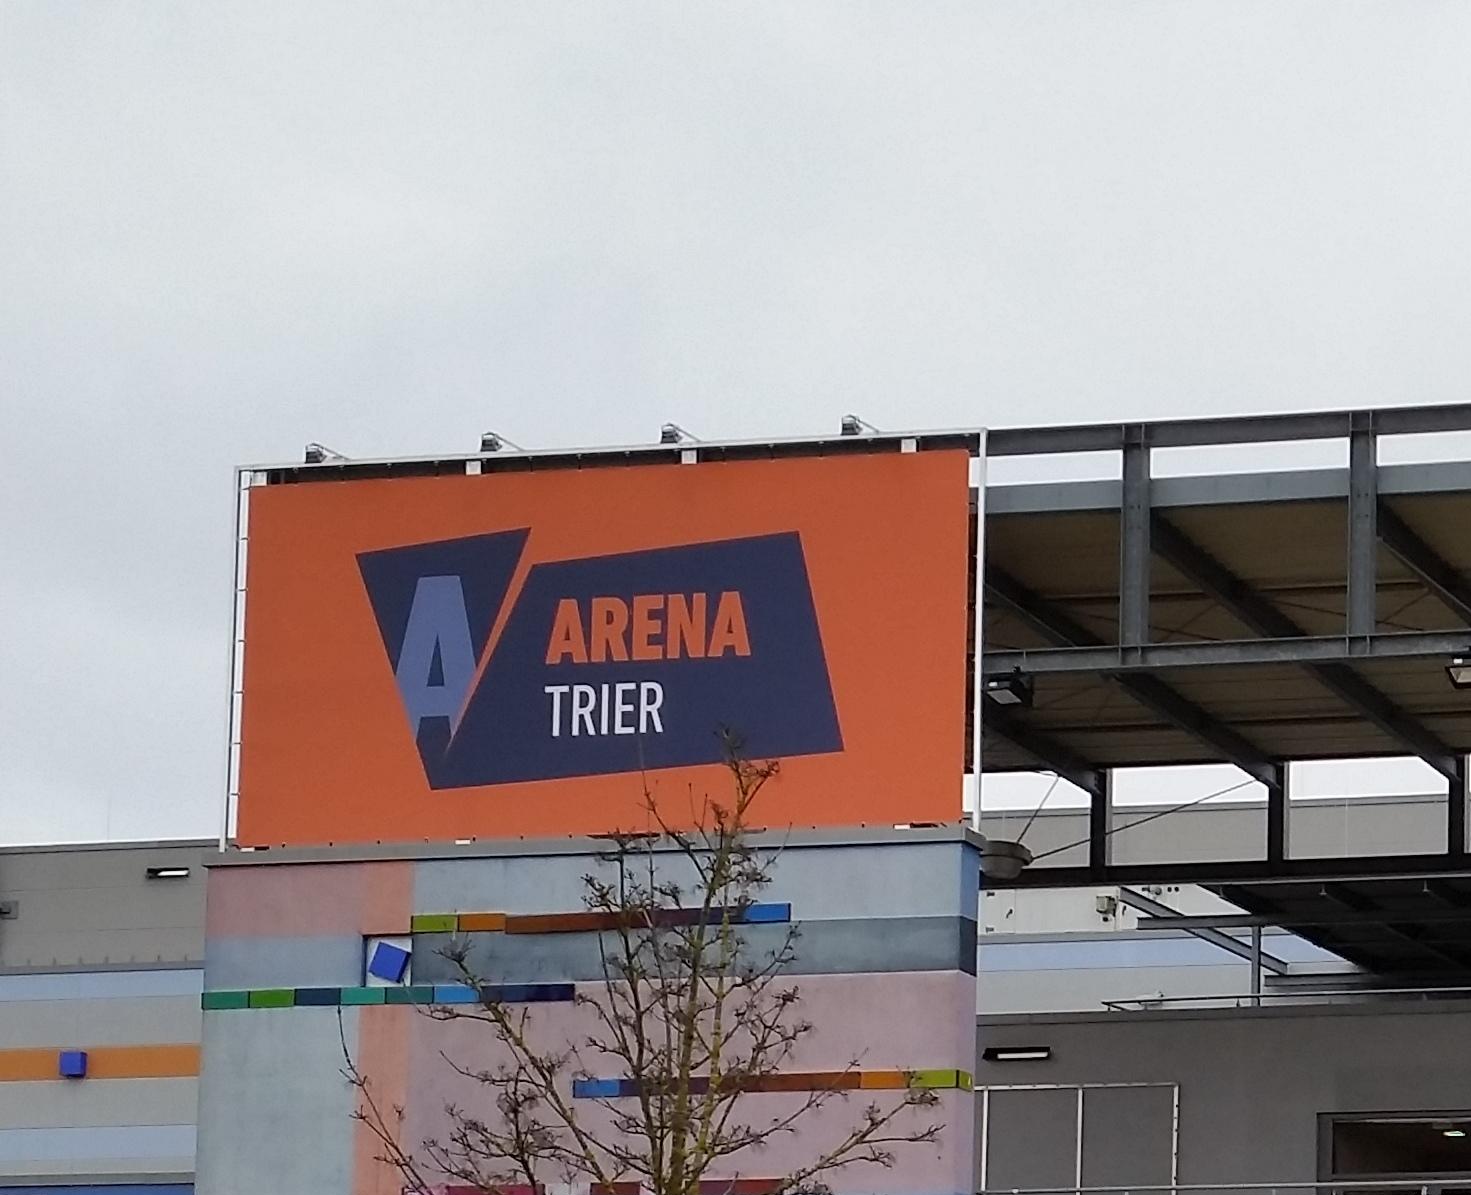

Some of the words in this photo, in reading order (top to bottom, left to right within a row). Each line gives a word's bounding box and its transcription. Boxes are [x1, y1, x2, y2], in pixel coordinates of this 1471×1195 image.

[395, 574, 478, 742] A
[545, 590, 751, 665] ARENA
[544, 680, 665, 737] TRIER
